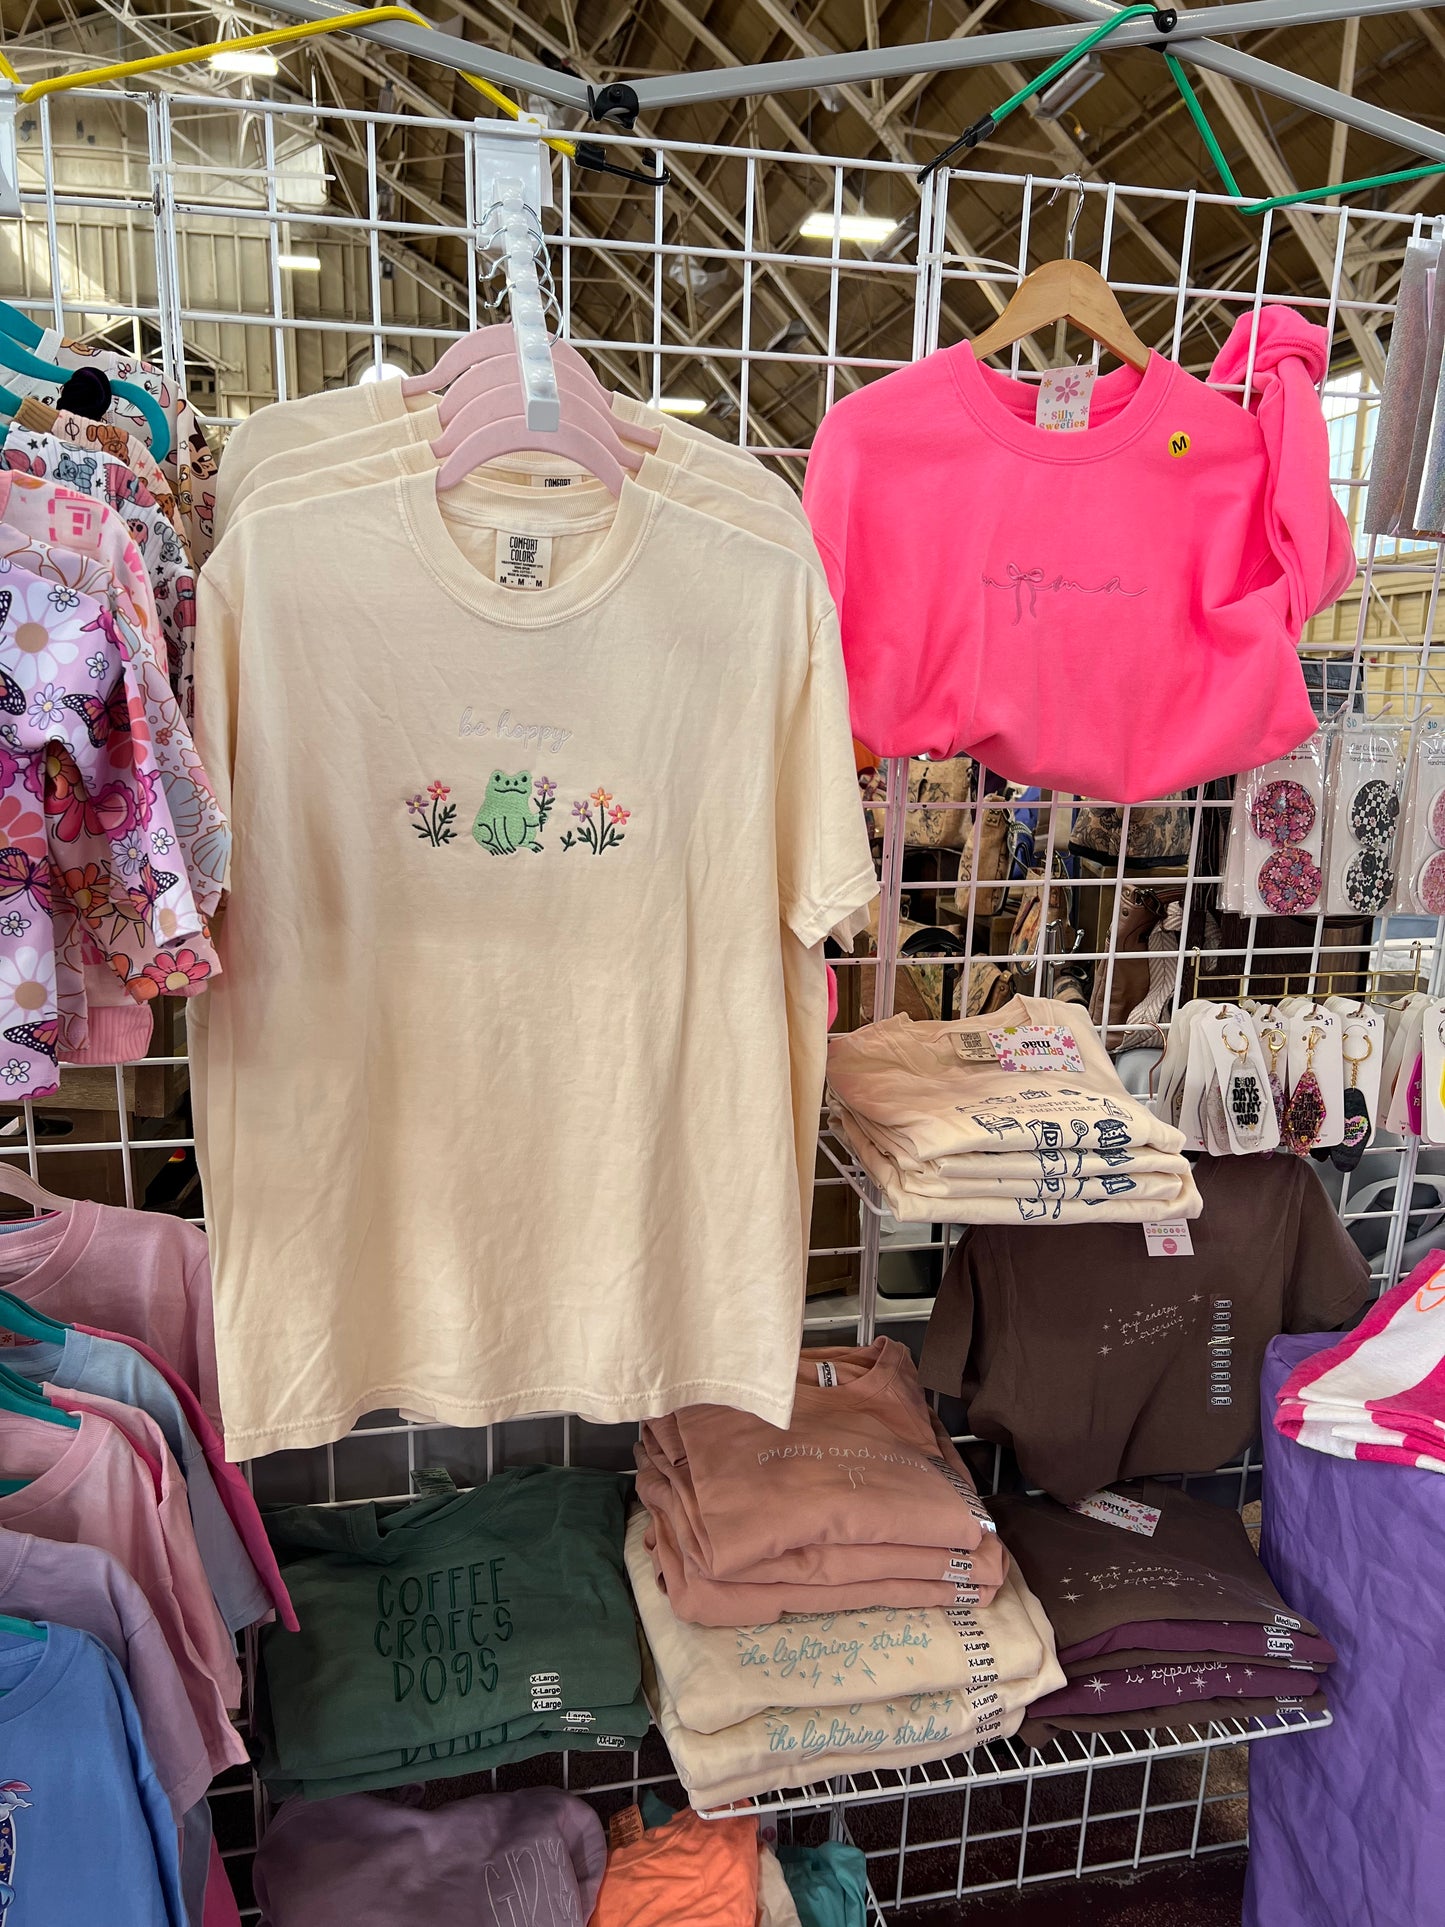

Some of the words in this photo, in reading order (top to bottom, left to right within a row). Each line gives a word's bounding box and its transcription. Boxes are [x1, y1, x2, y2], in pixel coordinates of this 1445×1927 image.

[1050, 409, 1075, 421] Silly
[1171, 436, 1188, 454] M
[509, 536, 539, 551] COMFORT
[510, 549, 536, 563] COLORS
[500, 576, 507, 584] M
[518, 578, 525, 586] M
[459, 706, 491, 737] be
[1324, 1017, 1333, 1026] $7
[1367, 1019, 1376, 1027] $7
[1021, 1040, 1051, 1049] mae
[1014, 1047, 1065, 1057] BRITTANY
[1232, 1088, 1260, 1101] DAYS
[1214, 1300, 1230, 1308] Small
[1213, 1312, 1230, 1320] Small
[1213, 1348, 1231, 1356] Small
[1212, 1360, 1229, 1368] Small
[1211, 1372, 1229, 1380] Small
[1211, 1384, 1230, 1392] Small
[1212, 1397, 1231, 1405] Small
[757, 1445, 825, 1465] pretty
[828, 1445, 875, 1459] and
[1086, 1500, 1139, 1523] BRITTANY
[951, 1559, 972, 1570] Large
[377, 1557, 511, 1619] COFFEE
[955, 1596, 979, 1604] X-Large
[1275, 1615, 1300, 1629] Medium
[958, 1629, 984, 1637] X-Large
[964, 1641, 990, 1651] X-Large
[1268, 1640, 1294, 1650] X-Large
[738, 1644, 769, 1667] the
[772, 1635, 864, 1678] lightning
[869, 1624, 932, 1651] strikes
[968, 1656, 995, 1667] X-Large
[531, 1675, 559, 1683] X-Large
[971, 1672, 999, 1684] X-Large
[1125, 1668, 1145, 1684] is
[532, 1687, 560, 1695] X-Large
[533, 1700, 561, 1710] X-Large
[971, 1691, 999, 1709] X-Large
[977, 1706, 1003, 1723] X-Large
[975, 1719, 1001, 1734] XX-Large
[598, 1735, 625, 1747] XX-Large
[767, 1724, 798, 1752] the
[799, 1717, 889, 1761] lightning
[893, 1714, 953, 1745] strikes
